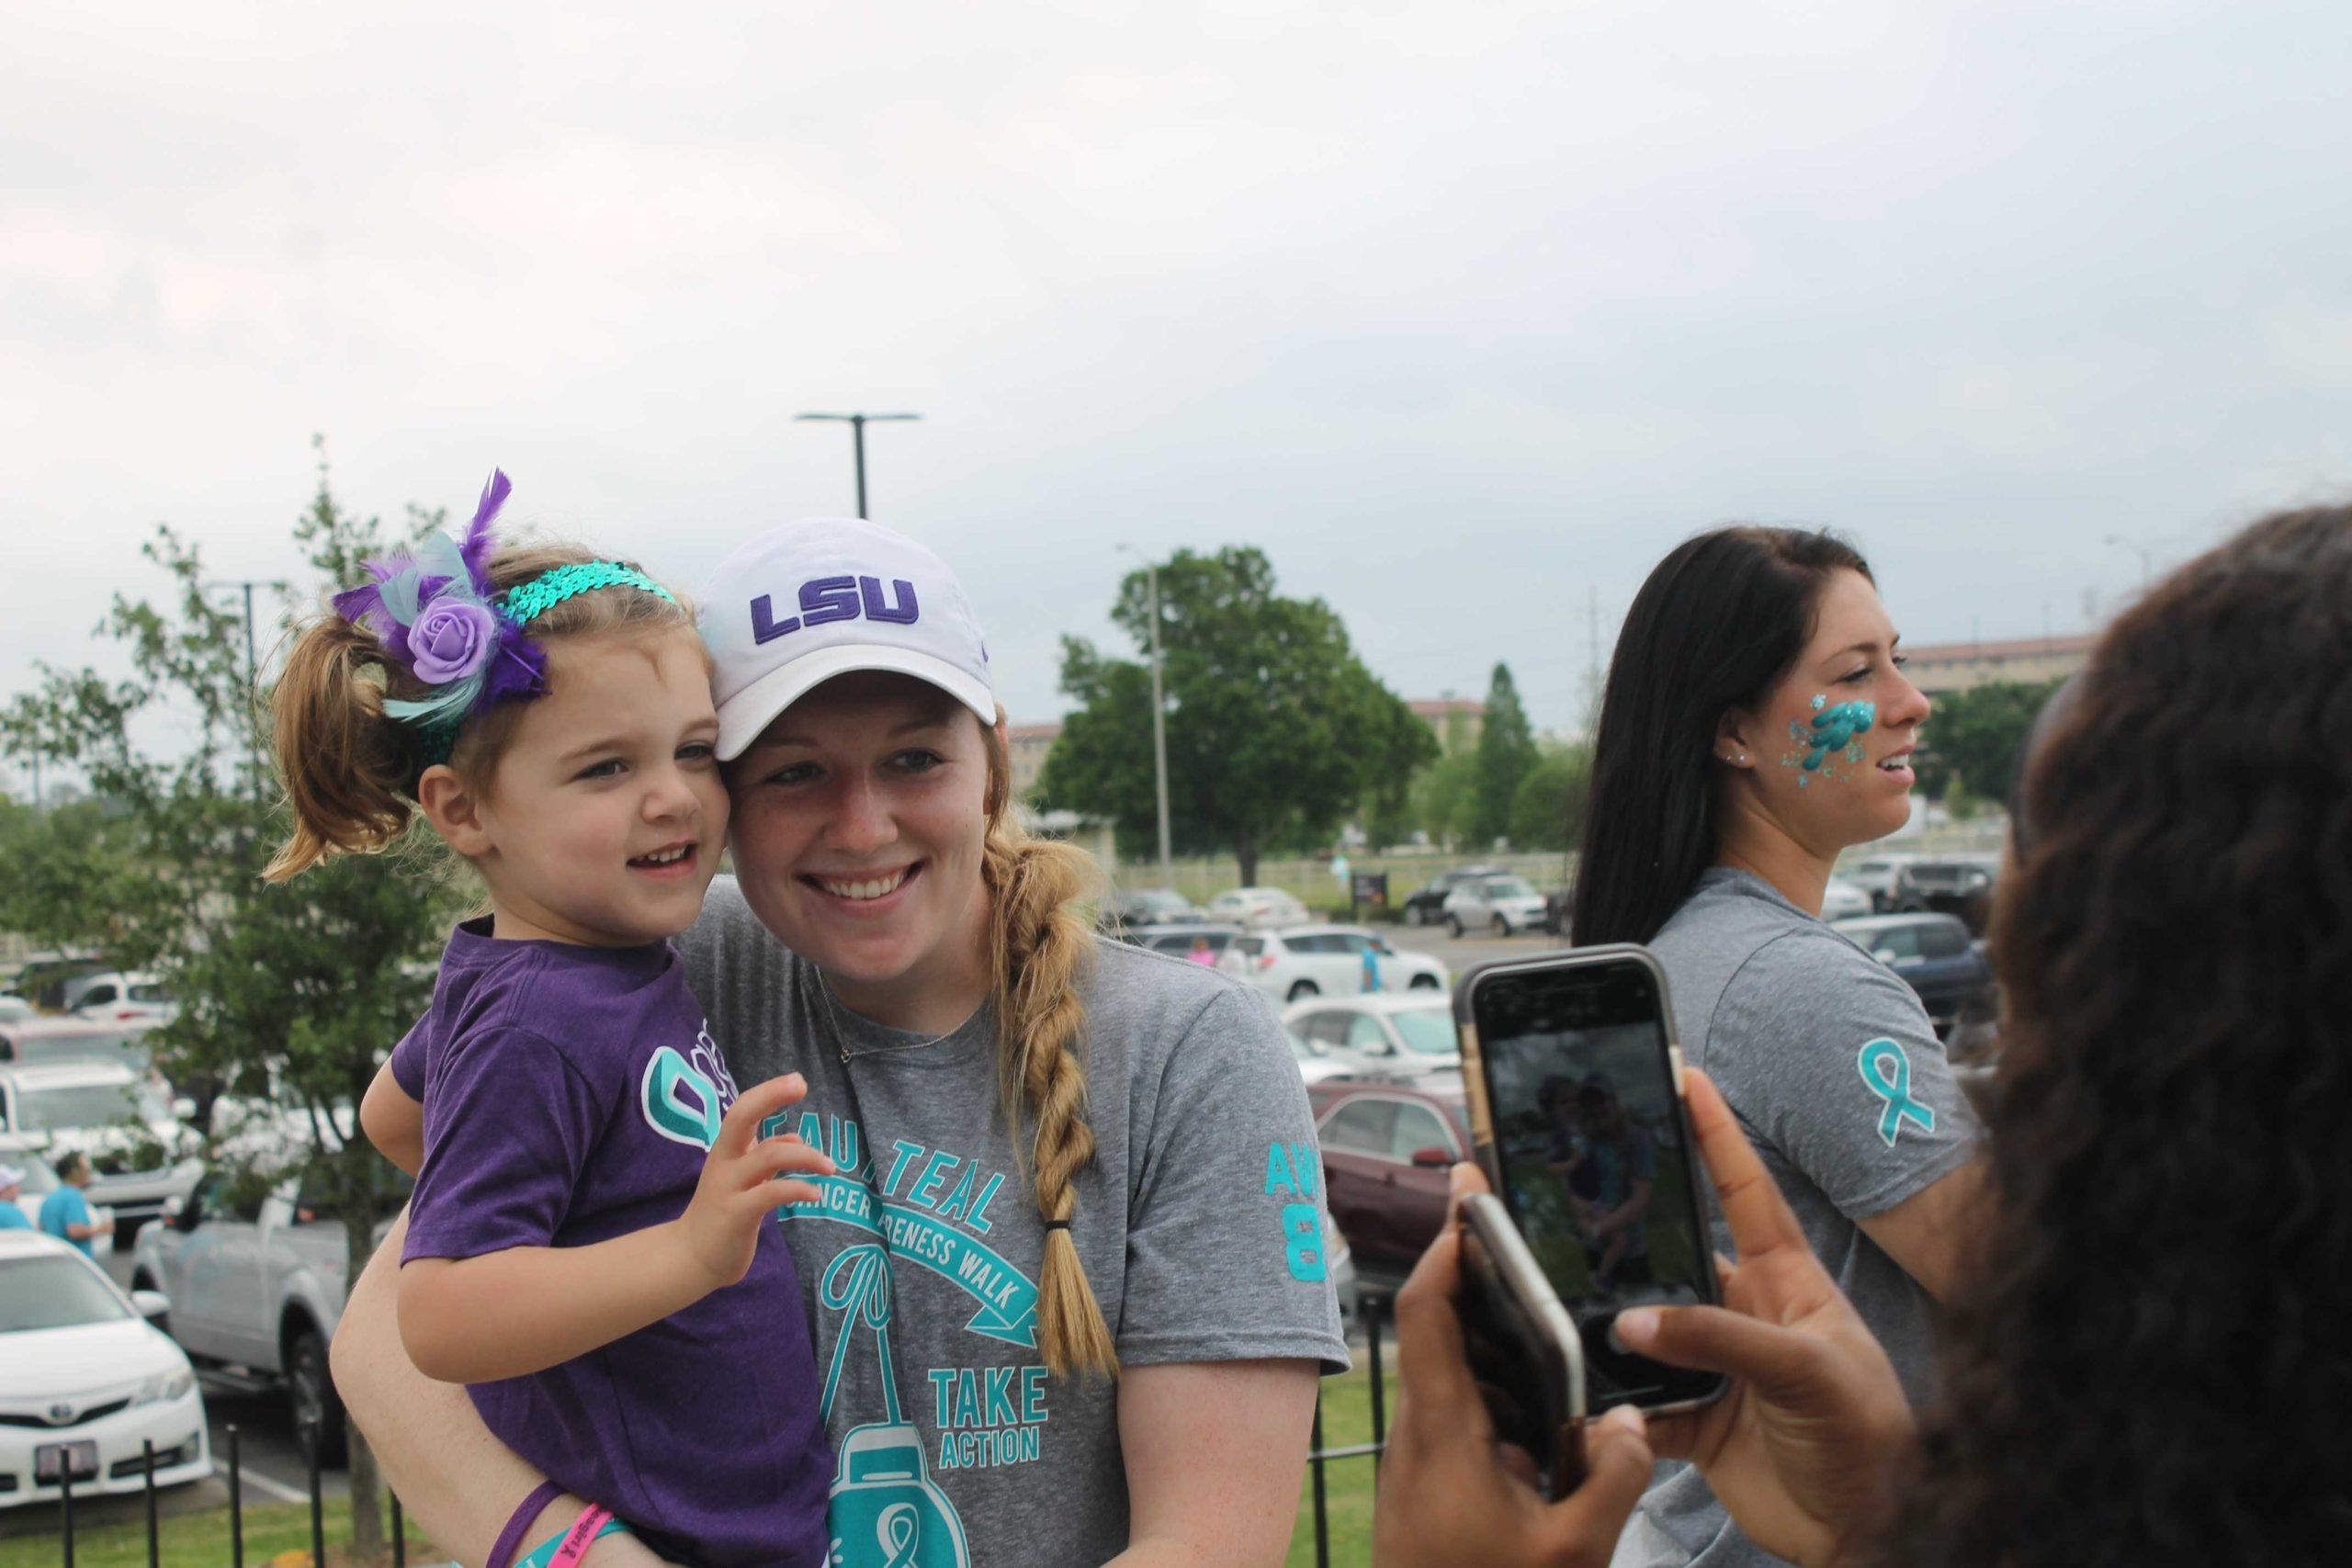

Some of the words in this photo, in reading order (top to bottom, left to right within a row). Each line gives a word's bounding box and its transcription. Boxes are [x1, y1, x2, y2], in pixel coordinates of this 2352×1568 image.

[750, 575, 919, 645] LSU
[882, 1139, 1006, 1235] TEAL
[786, 1182, 871, 1221] NCER
[957, 1248, 1020, 1310] WALK
[928, 1366, 1048, 1429] TAKE
[938, 1426, 1040, 1470] ACTION
